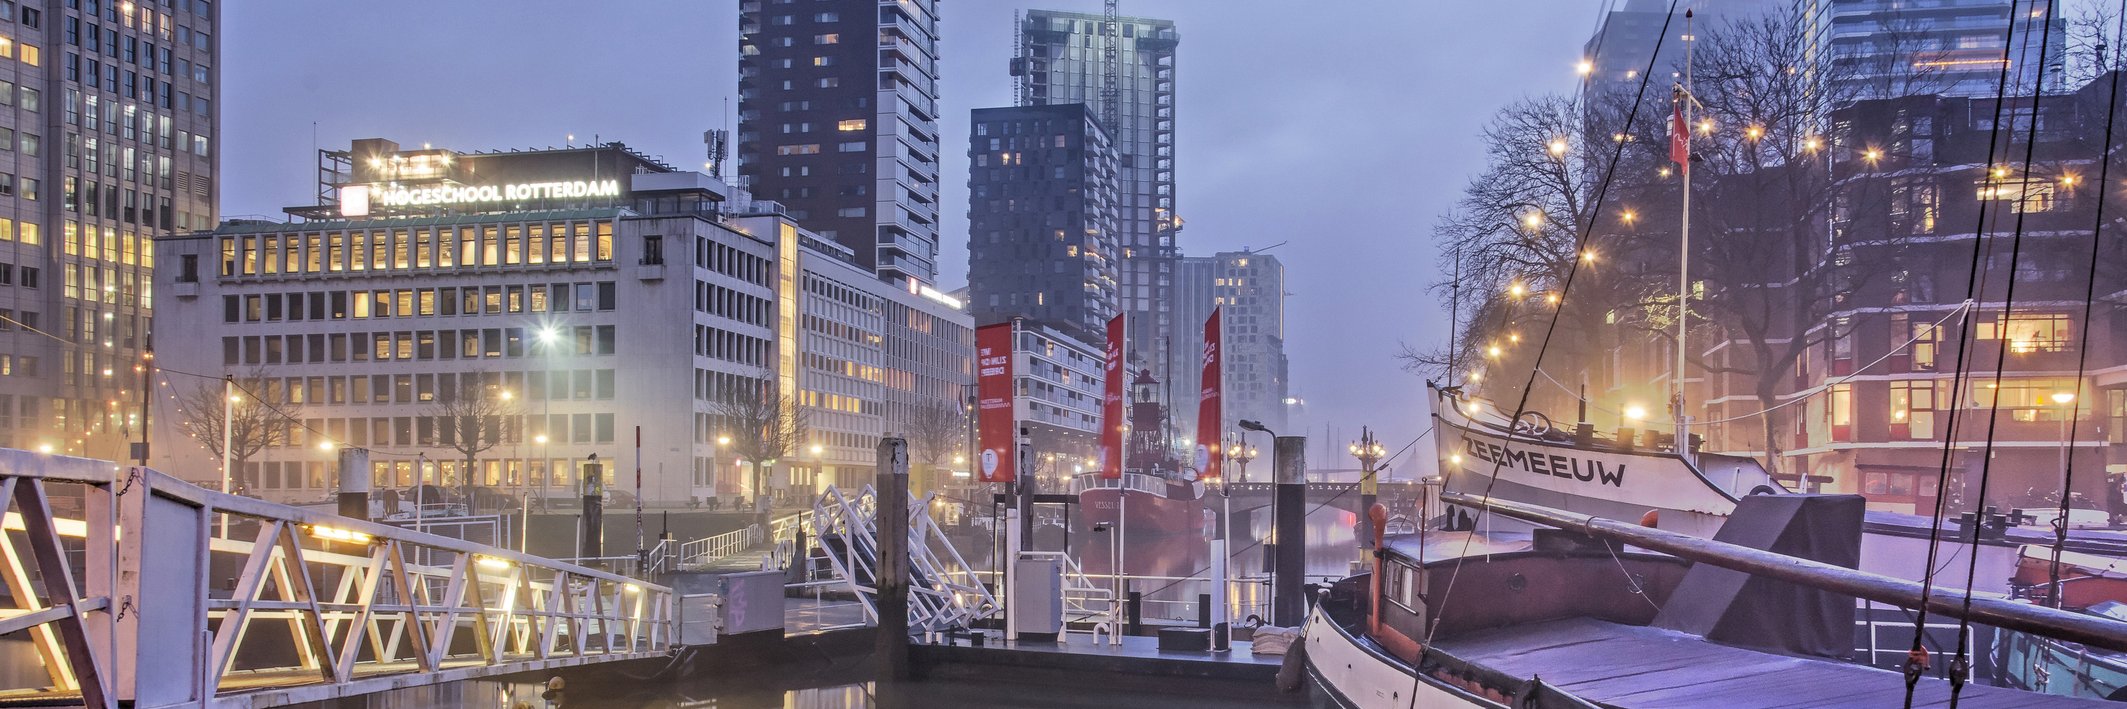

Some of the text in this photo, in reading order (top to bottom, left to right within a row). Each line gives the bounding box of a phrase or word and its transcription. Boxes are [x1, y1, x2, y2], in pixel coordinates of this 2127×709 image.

[383, 179, 619, 207] HOGESCHOOL ROTTERDAM
[1460, 435, 1626, 488] ZEEMEEUW
